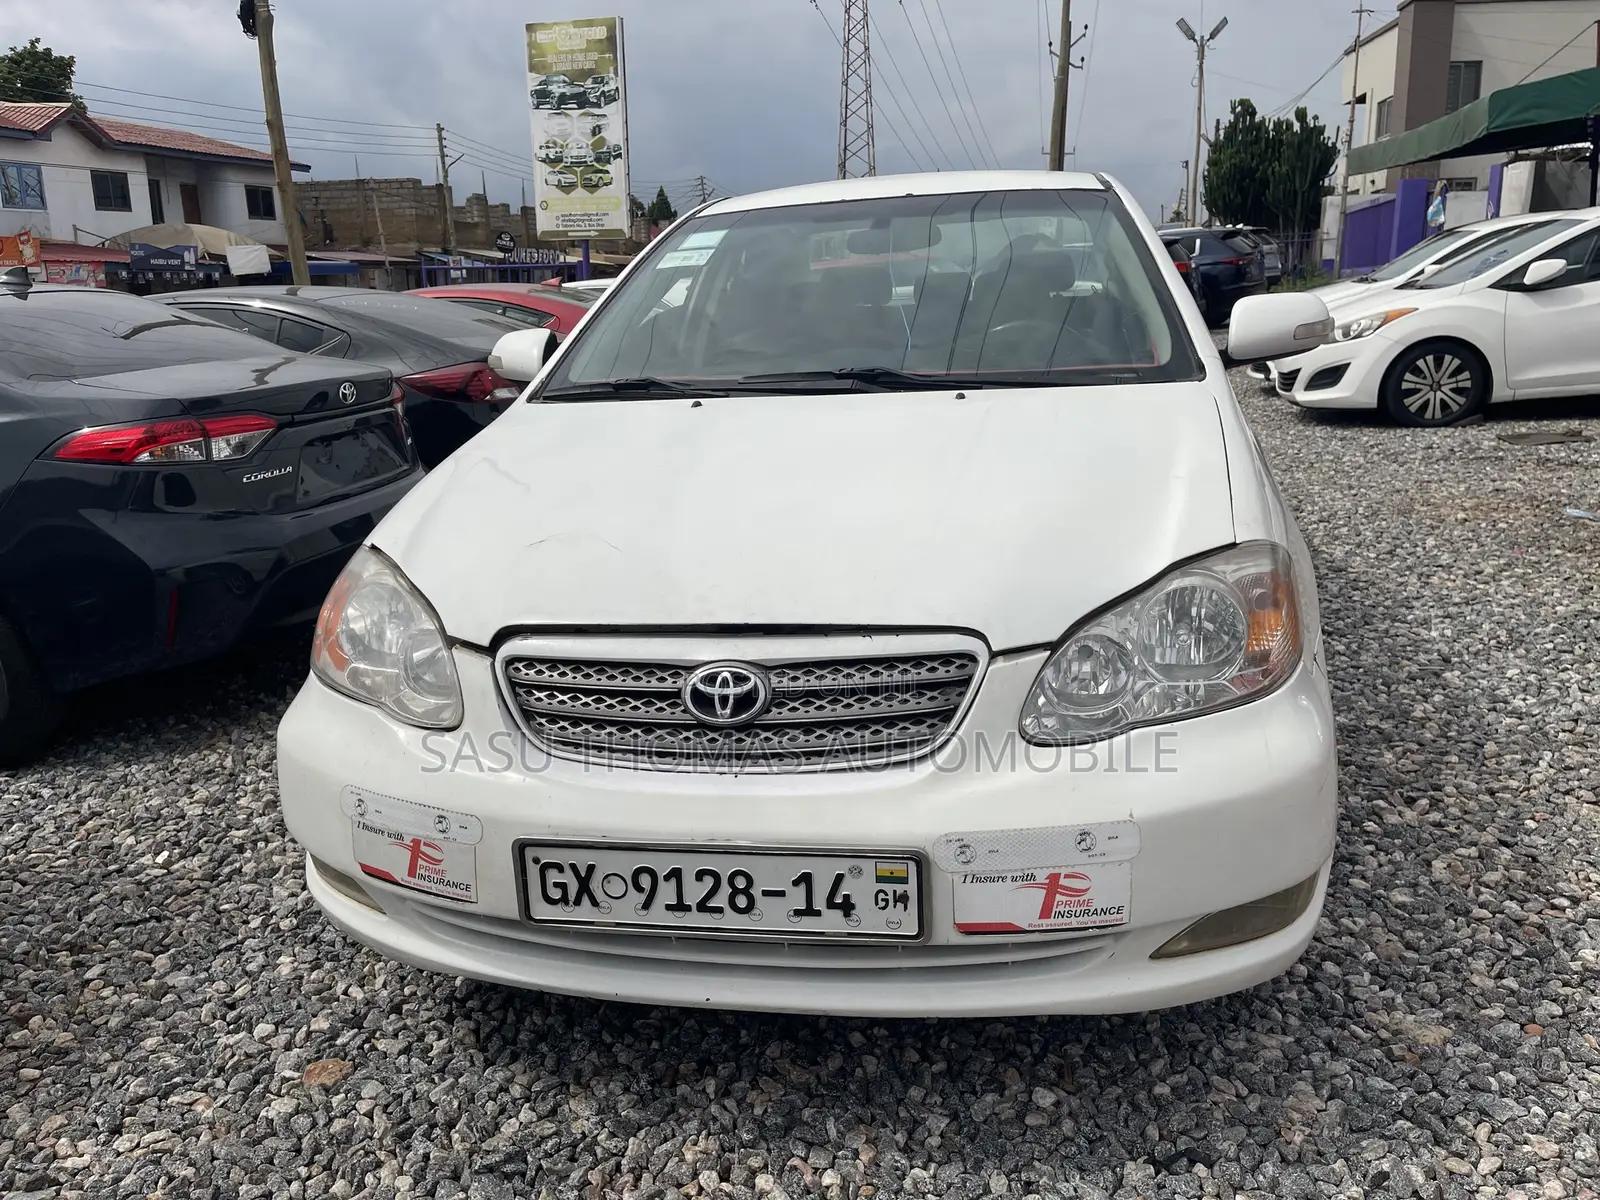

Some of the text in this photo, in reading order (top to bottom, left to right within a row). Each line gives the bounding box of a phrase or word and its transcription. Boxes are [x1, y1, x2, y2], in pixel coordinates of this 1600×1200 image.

[242, 465, 293, 483] COROLLA
[361, 822, 386, 837] Insure
[387, 831, 405, 842] with
[418, 863, 448, 878] PRIME
[961, 872, 1037, 884] I Insure with
[417, 873, 472, 893] INSURANCE
[538, 861, 856, 918] GX 9128-14
[874, 889, 910, 913] GH
[1055, 898, 1094, 909] PRIME
[1053, 905, 1124, 919] INSURANCE
[1098, 916, 1124, 924] insured
